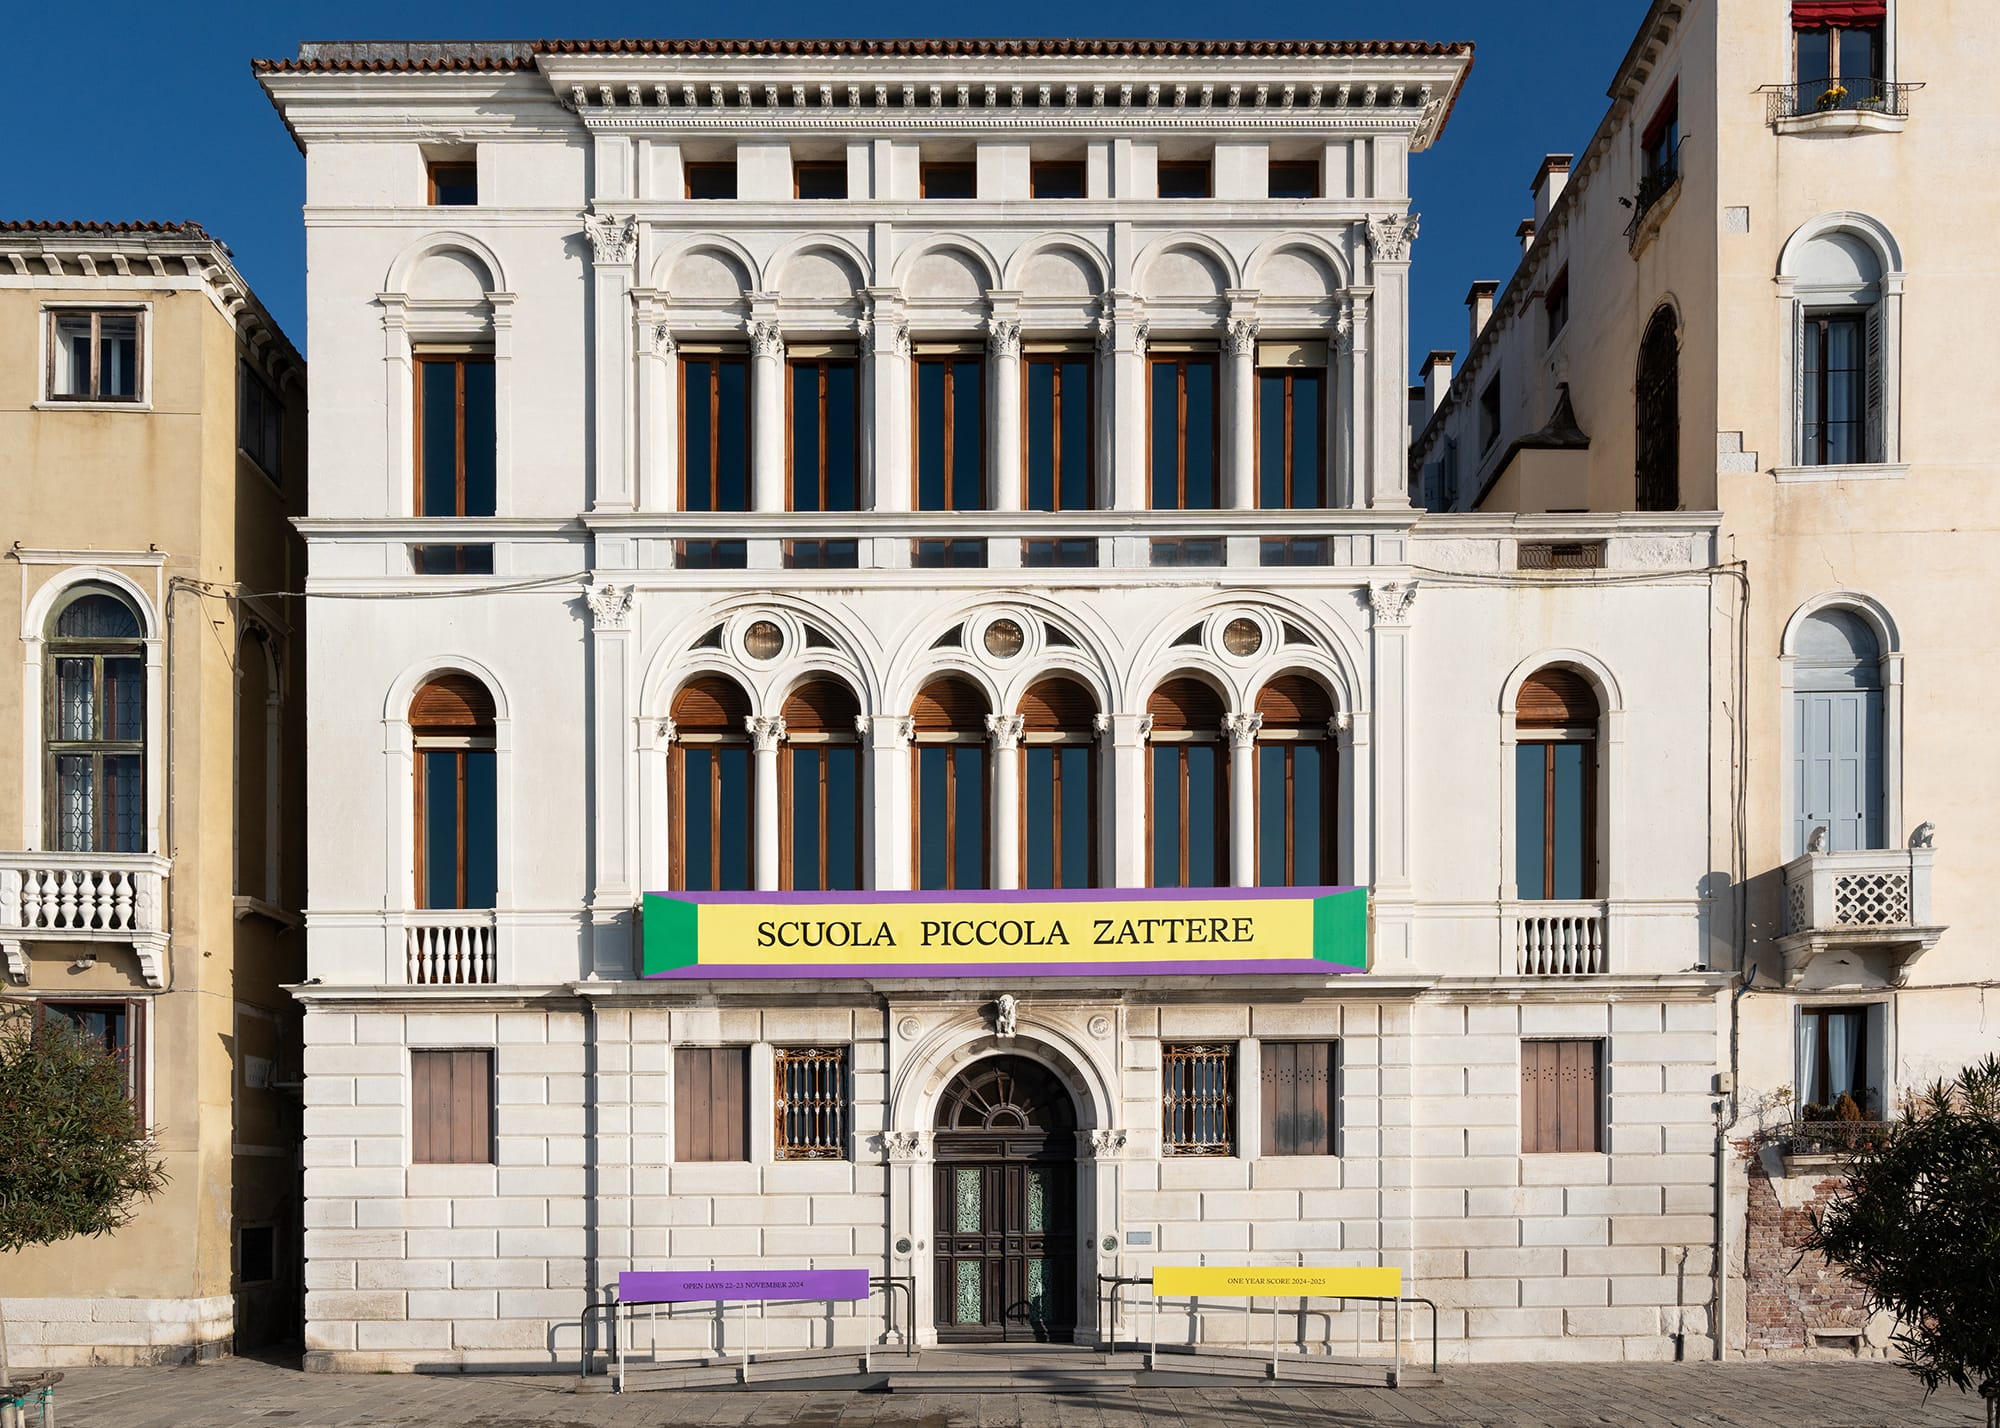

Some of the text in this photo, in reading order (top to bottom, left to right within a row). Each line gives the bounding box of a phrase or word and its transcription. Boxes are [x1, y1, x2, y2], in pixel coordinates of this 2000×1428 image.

[758, 917, 1255, 947] SCUOLA PICCOLA ZATTERE
[682, 1282, 704, 1290] OPEN
[745, 1281, 788, 1289] NOVEMBER
[1227, 1277, 1244, 1285] ONE
[1245, 1277, 1265, 1285] YEAR
[1266, 1277, 1290, 1285] SCORE
